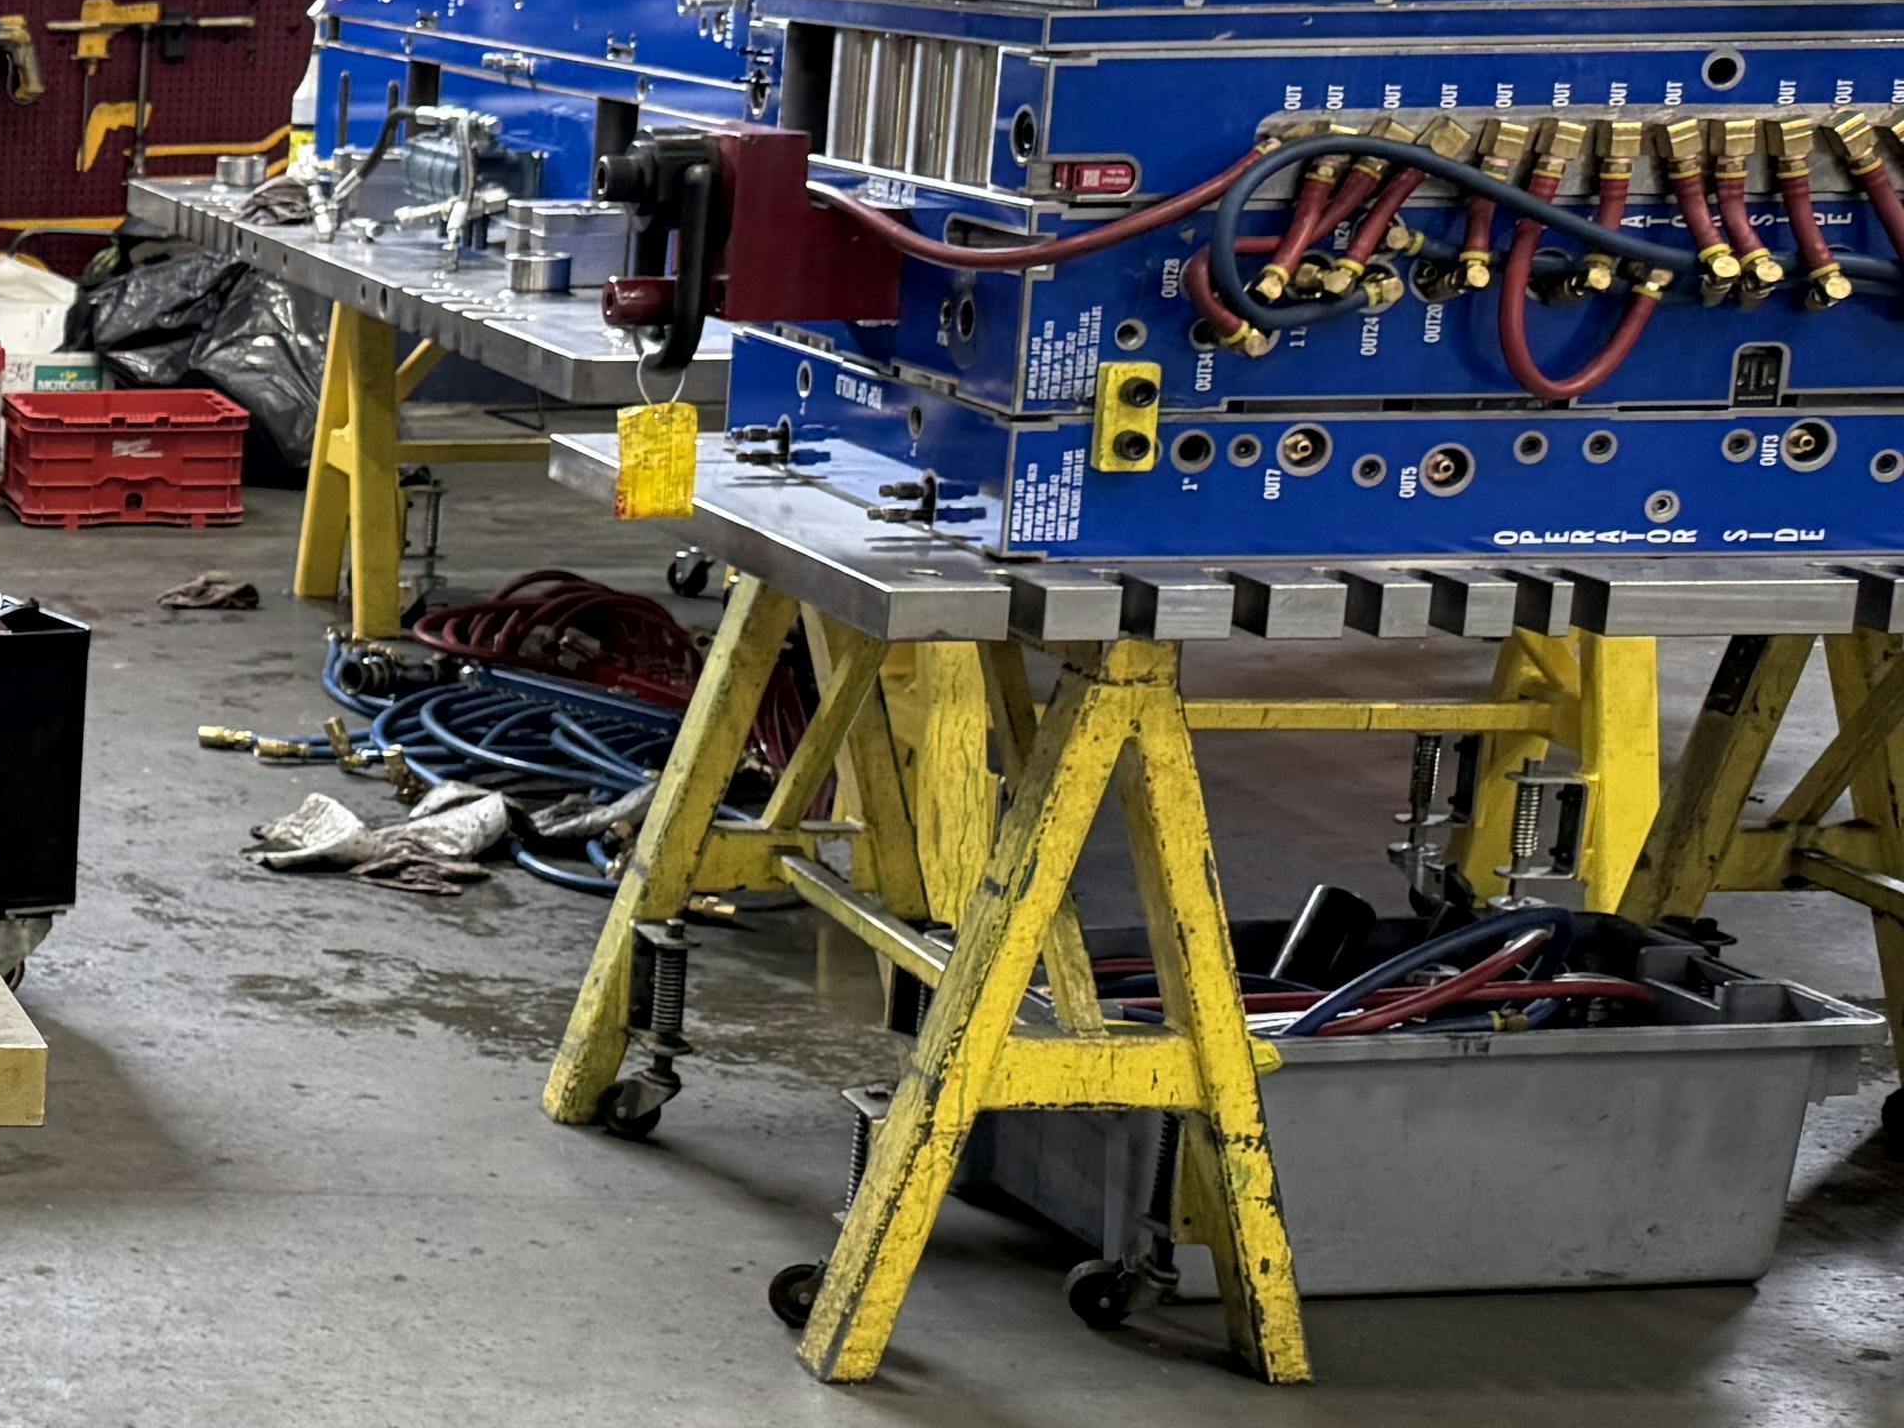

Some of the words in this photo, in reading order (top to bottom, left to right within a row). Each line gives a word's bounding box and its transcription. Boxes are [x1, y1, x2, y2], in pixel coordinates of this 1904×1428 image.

[1284, 84, 1302, 111] OUT
[1326, 84, 1344, 111] OUT
[1383, 83, 1402, 110] OUT
[1440, 83, 1458, 110] OUT
[1495, 82, 1514, 109] OUT
[1552, 82, 1571, 109] OUT
[1608, 81, 1628, 107] OUT
[1663, 80, 1684, 106] OUT
[1777, 79, 1797, 106] OUT
[1834, 78, 1854, 105] OUT
[1161, 258, 1180, 299] OUT28
[1360, 316, 1380, 357] OUT24
[1423, 303, 1444, 344] OUT20
[1759, 434, 1780, 467] OUT3
[1263, 468, 1282, 500] OUT7
[1398, 466, 1418, 499] OUT5
[1493, 528, 1699, 546] OPERATOR
[1722, 527, 1826, 543] SIDE
